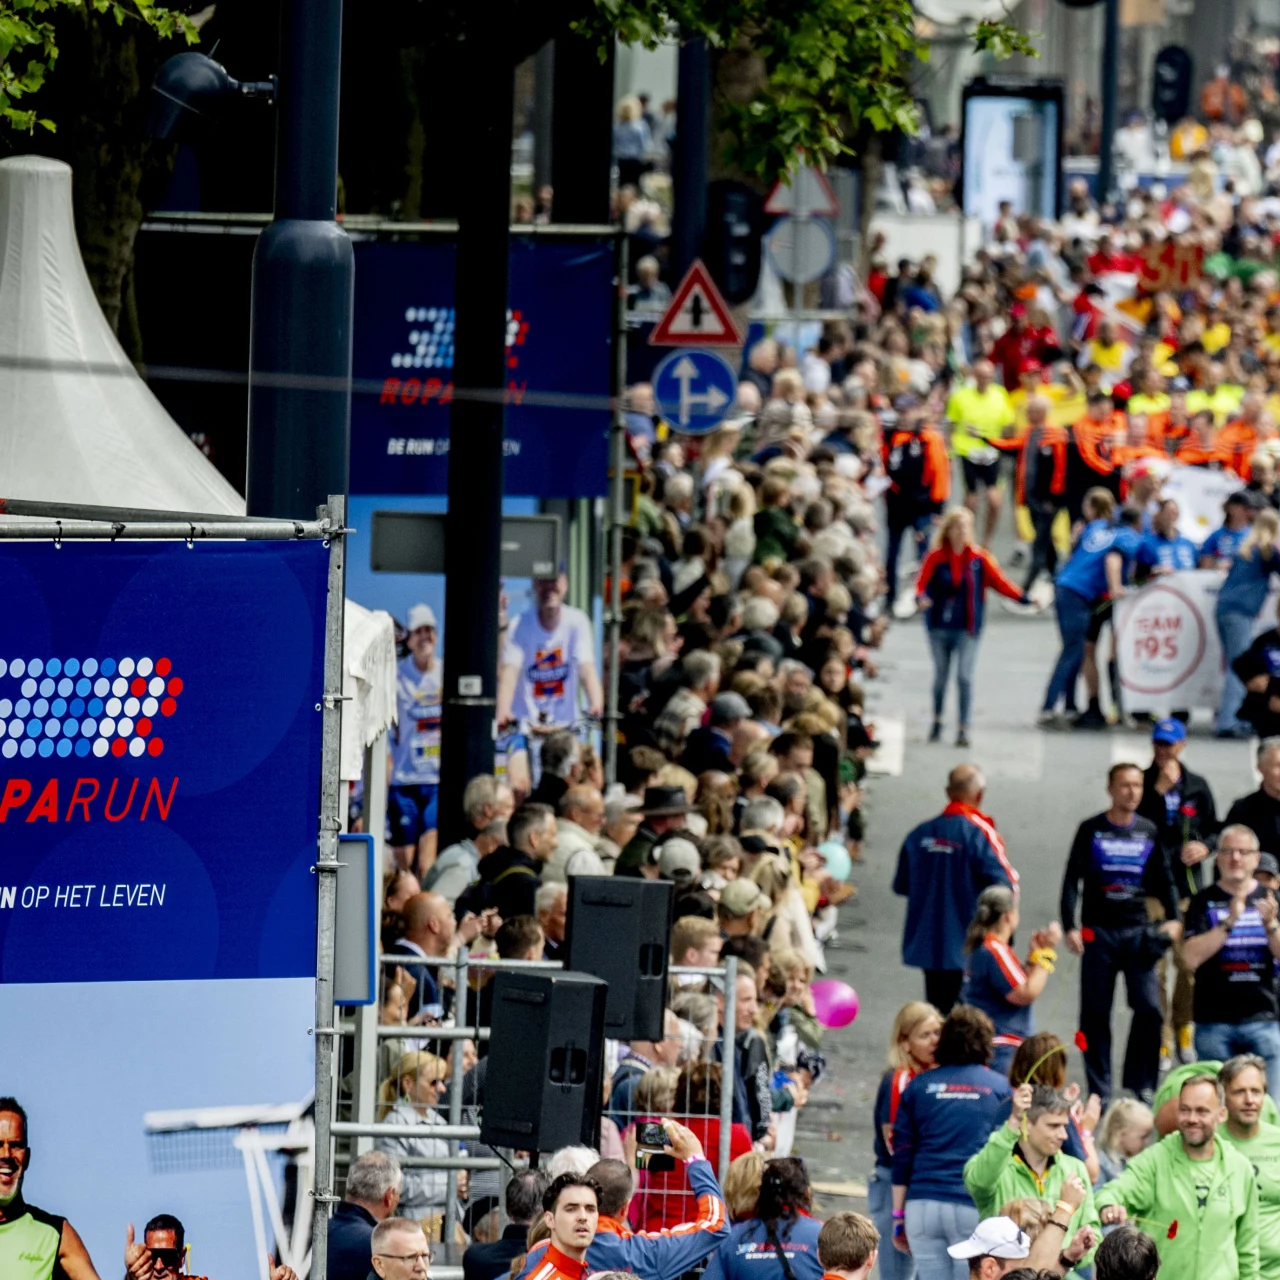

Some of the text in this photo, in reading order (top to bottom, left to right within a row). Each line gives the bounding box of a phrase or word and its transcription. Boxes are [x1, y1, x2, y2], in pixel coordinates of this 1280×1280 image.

[379, 379, 525, 406] ROPAN
[21, 885, 50, 909] OP
[54, 885, 97, 908] HET
[99, 883, 167, 908] LEVEN
